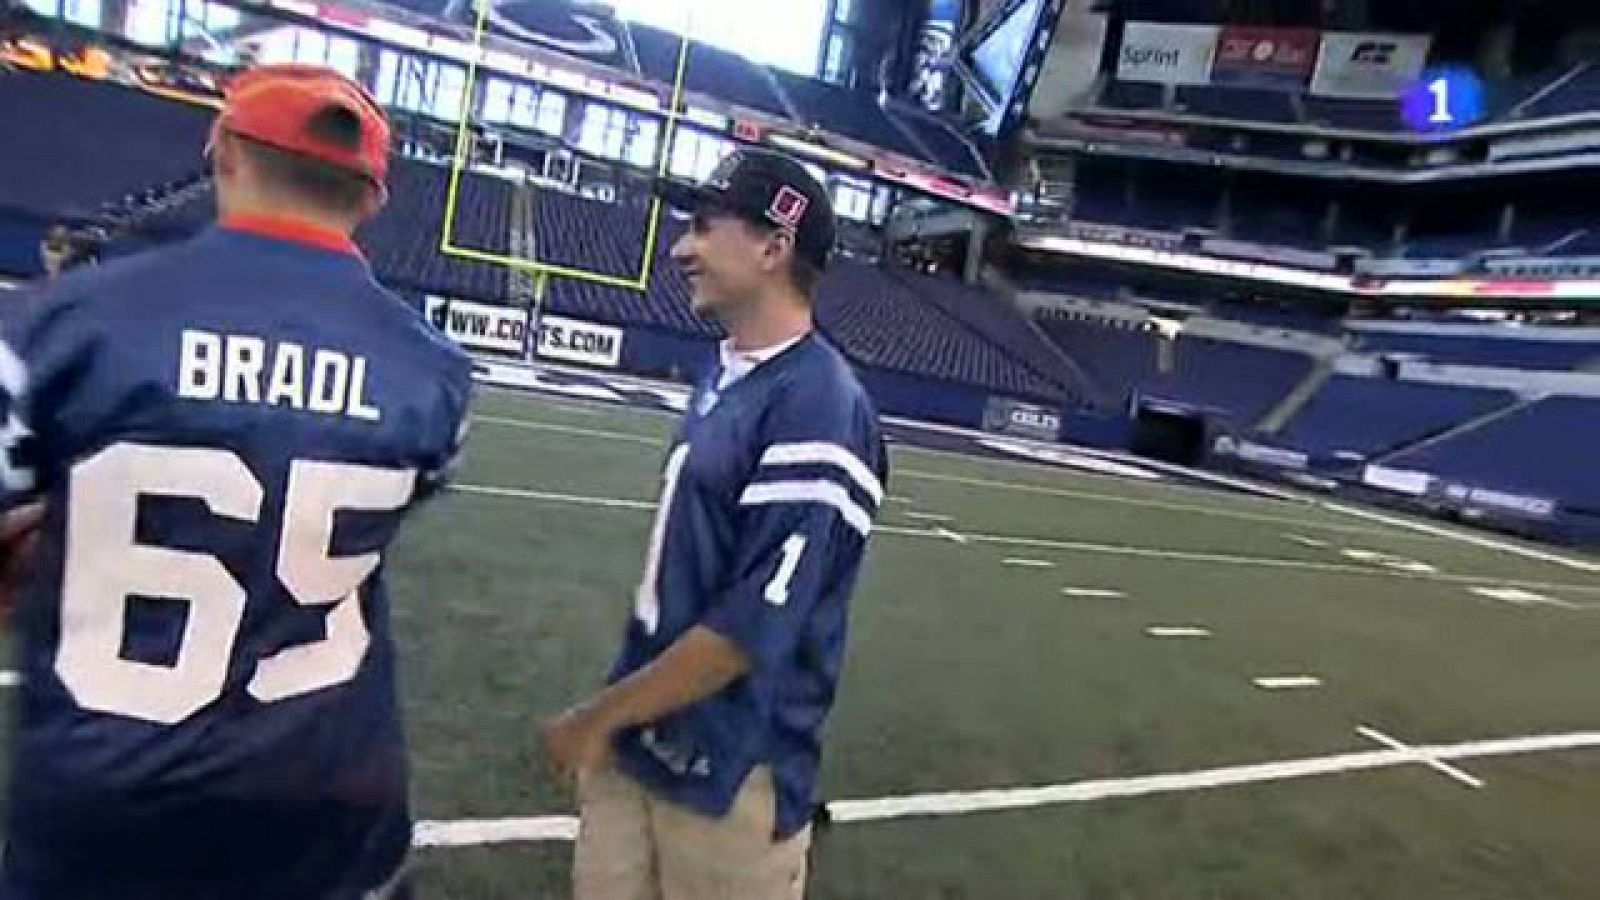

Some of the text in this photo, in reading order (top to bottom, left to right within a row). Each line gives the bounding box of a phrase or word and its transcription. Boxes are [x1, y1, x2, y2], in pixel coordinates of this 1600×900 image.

[1121, 43, 1180, 67] Sprint
[178, 329, 381, 421] BRADL
[54, 441, 419, 725] 65
[764, 532, 807, 606] 1
